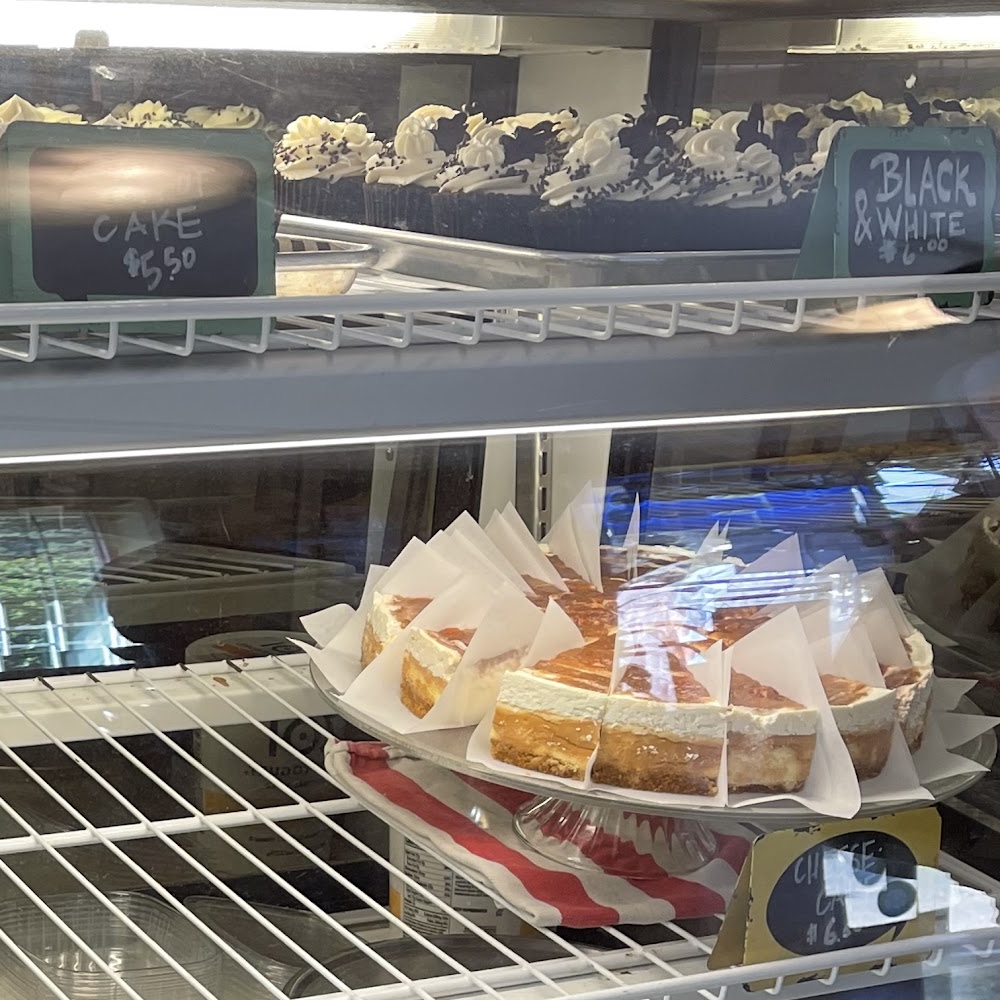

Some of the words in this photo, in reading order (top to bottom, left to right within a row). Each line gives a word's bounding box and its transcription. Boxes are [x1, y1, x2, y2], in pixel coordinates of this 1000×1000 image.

[870, 152, 976, 207] BLACK
[93, 205, 203, 242] CAKE
[855, 188, 872, 246] &
[876, 204, 966, 242] WHITE
